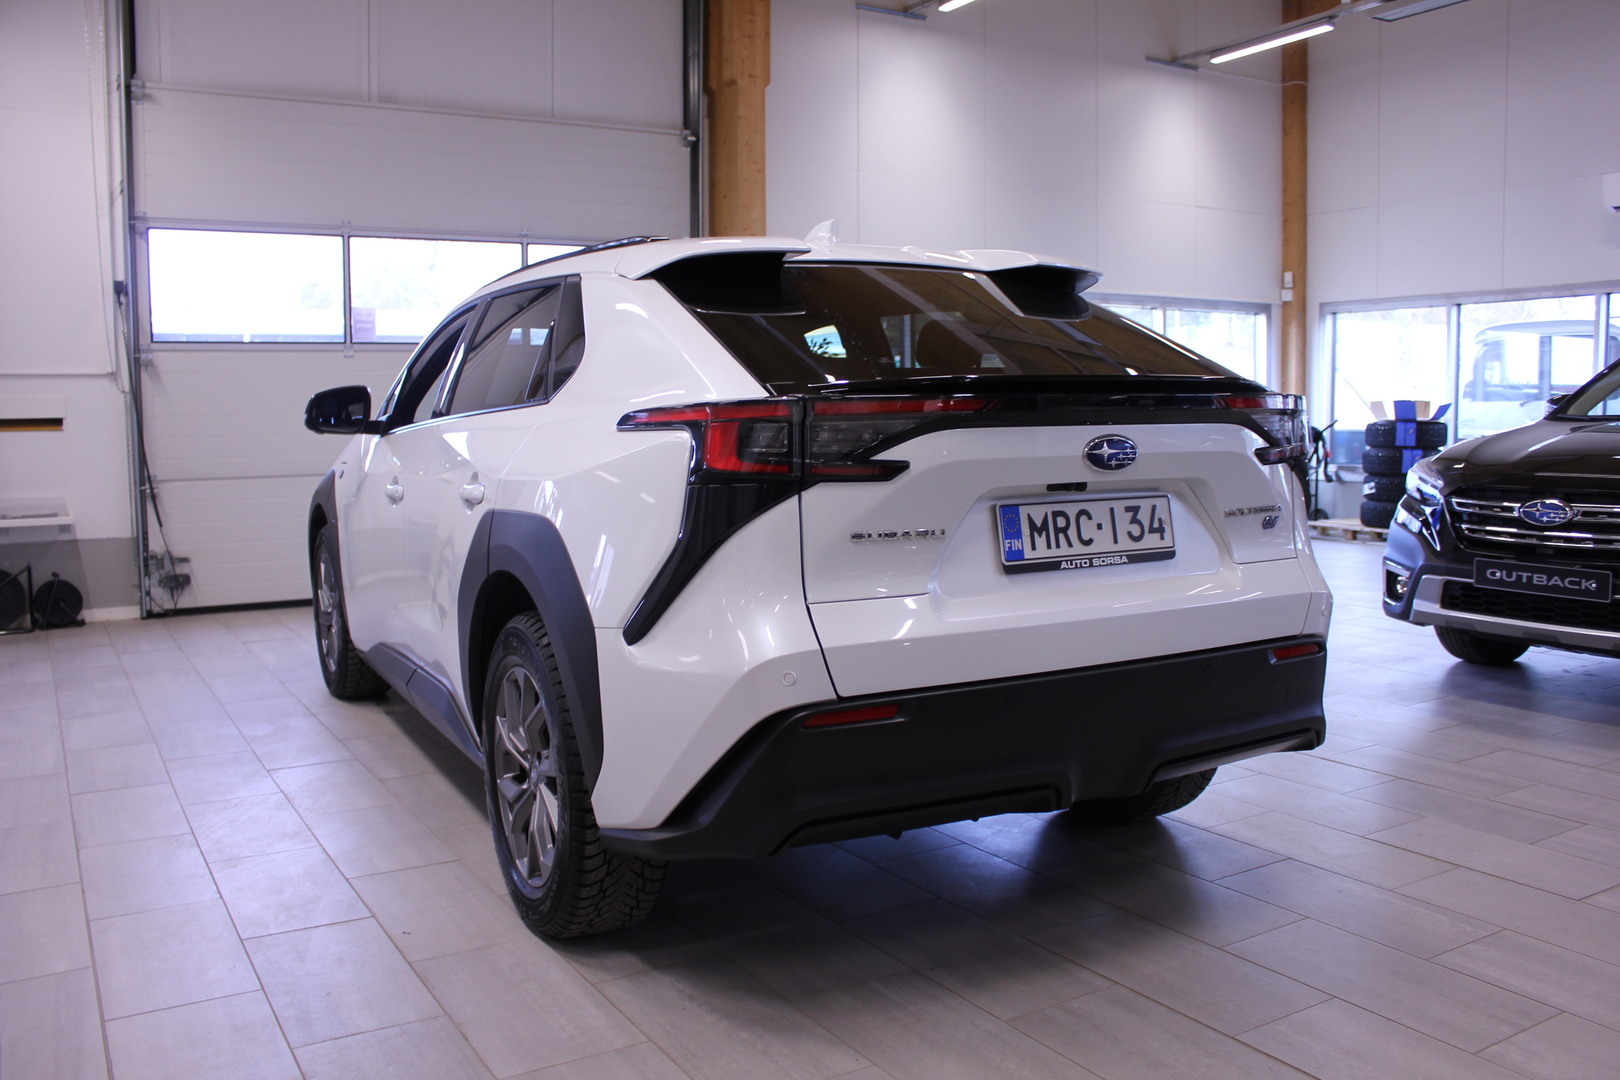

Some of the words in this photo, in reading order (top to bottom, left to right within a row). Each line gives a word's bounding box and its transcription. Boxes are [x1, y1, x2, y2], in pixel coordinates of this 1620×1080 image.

[850, 528, 946, 541] SUBARU
[1005, 538, 1023, 551] FIN
[1060, 557, 1090, 569] AUTO
[1092, 555, 1129, 567] SORSA
[1485, 568, 1597, 591] OUTBACK
